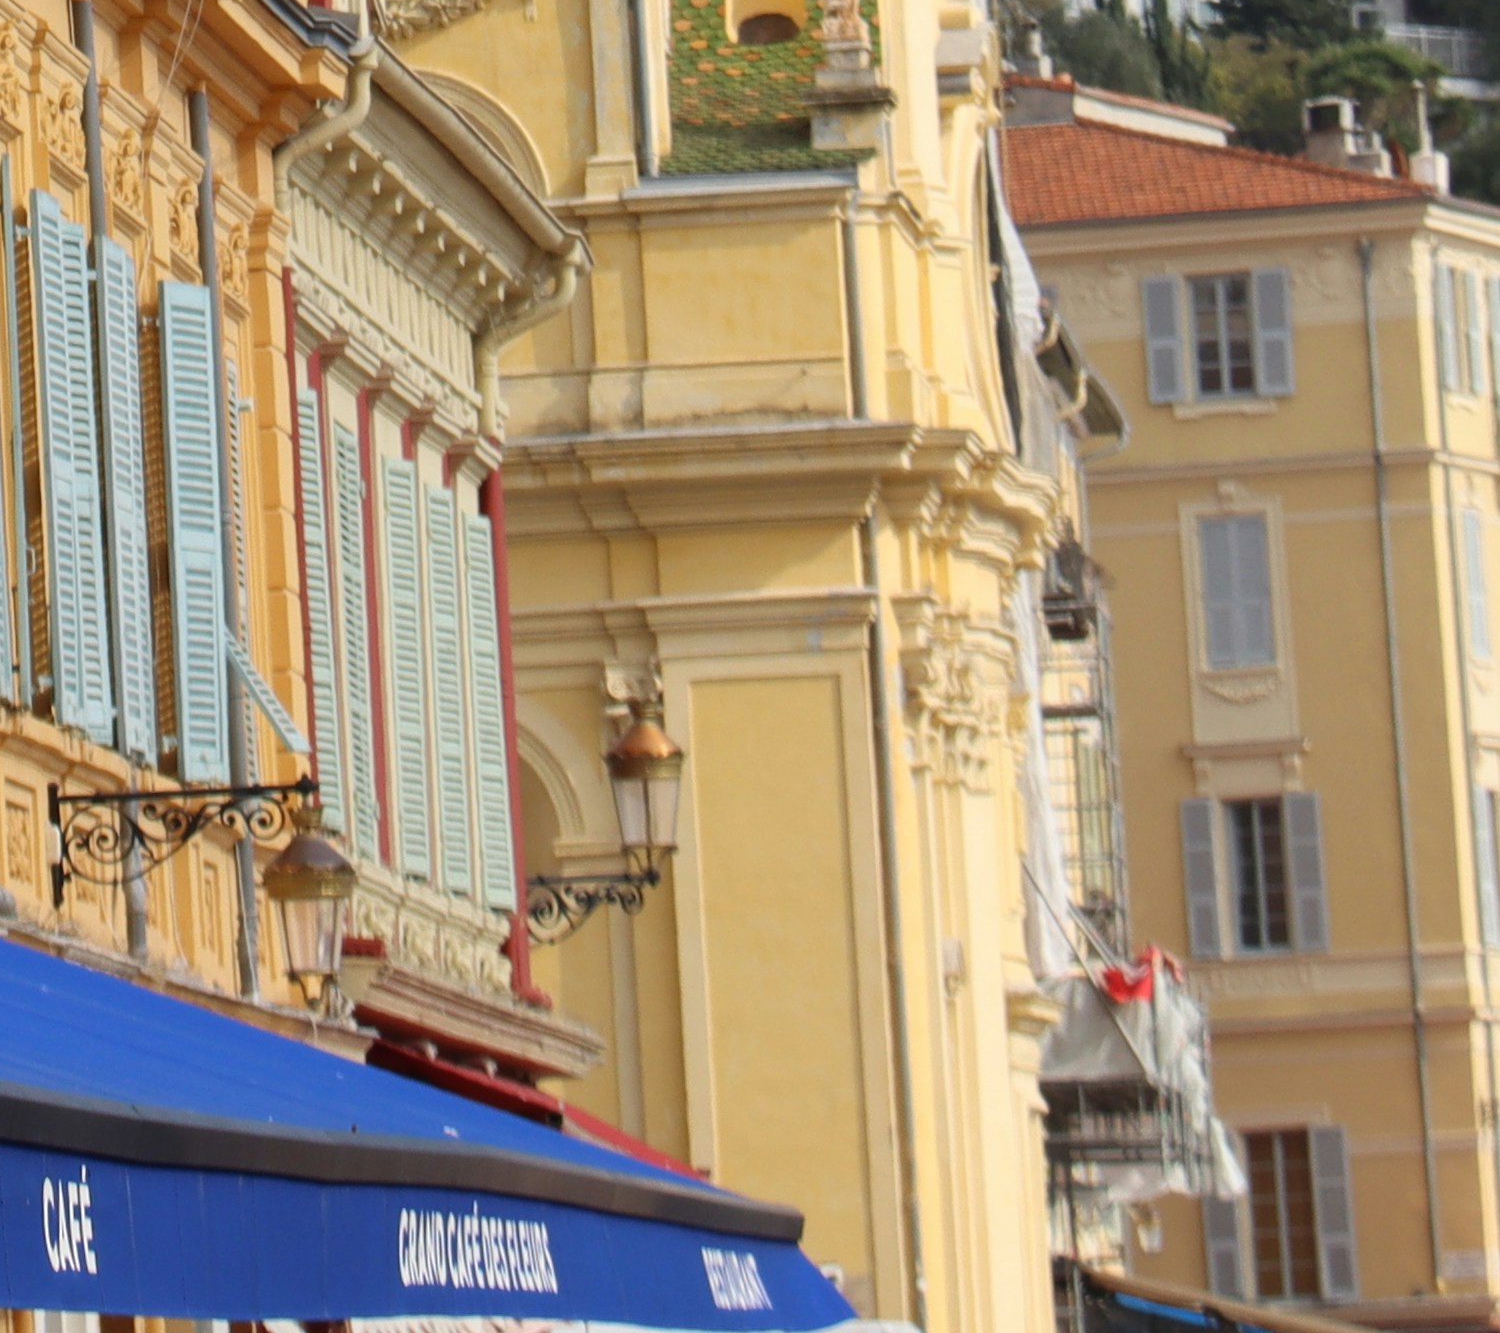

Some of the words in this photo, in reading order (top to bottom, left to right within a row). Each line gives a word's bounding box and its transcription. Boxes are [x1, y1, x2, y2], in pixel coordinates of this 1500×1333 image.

[42, 1163, 98, 1275] CAFÉ
[398, 1207, 448, 1288] GRAND
[447, 1199, 485, 1290] CAFÉ
[481, 1216, 511, 1292] DES
[505, 1219, 559, 1295] FLEURS
